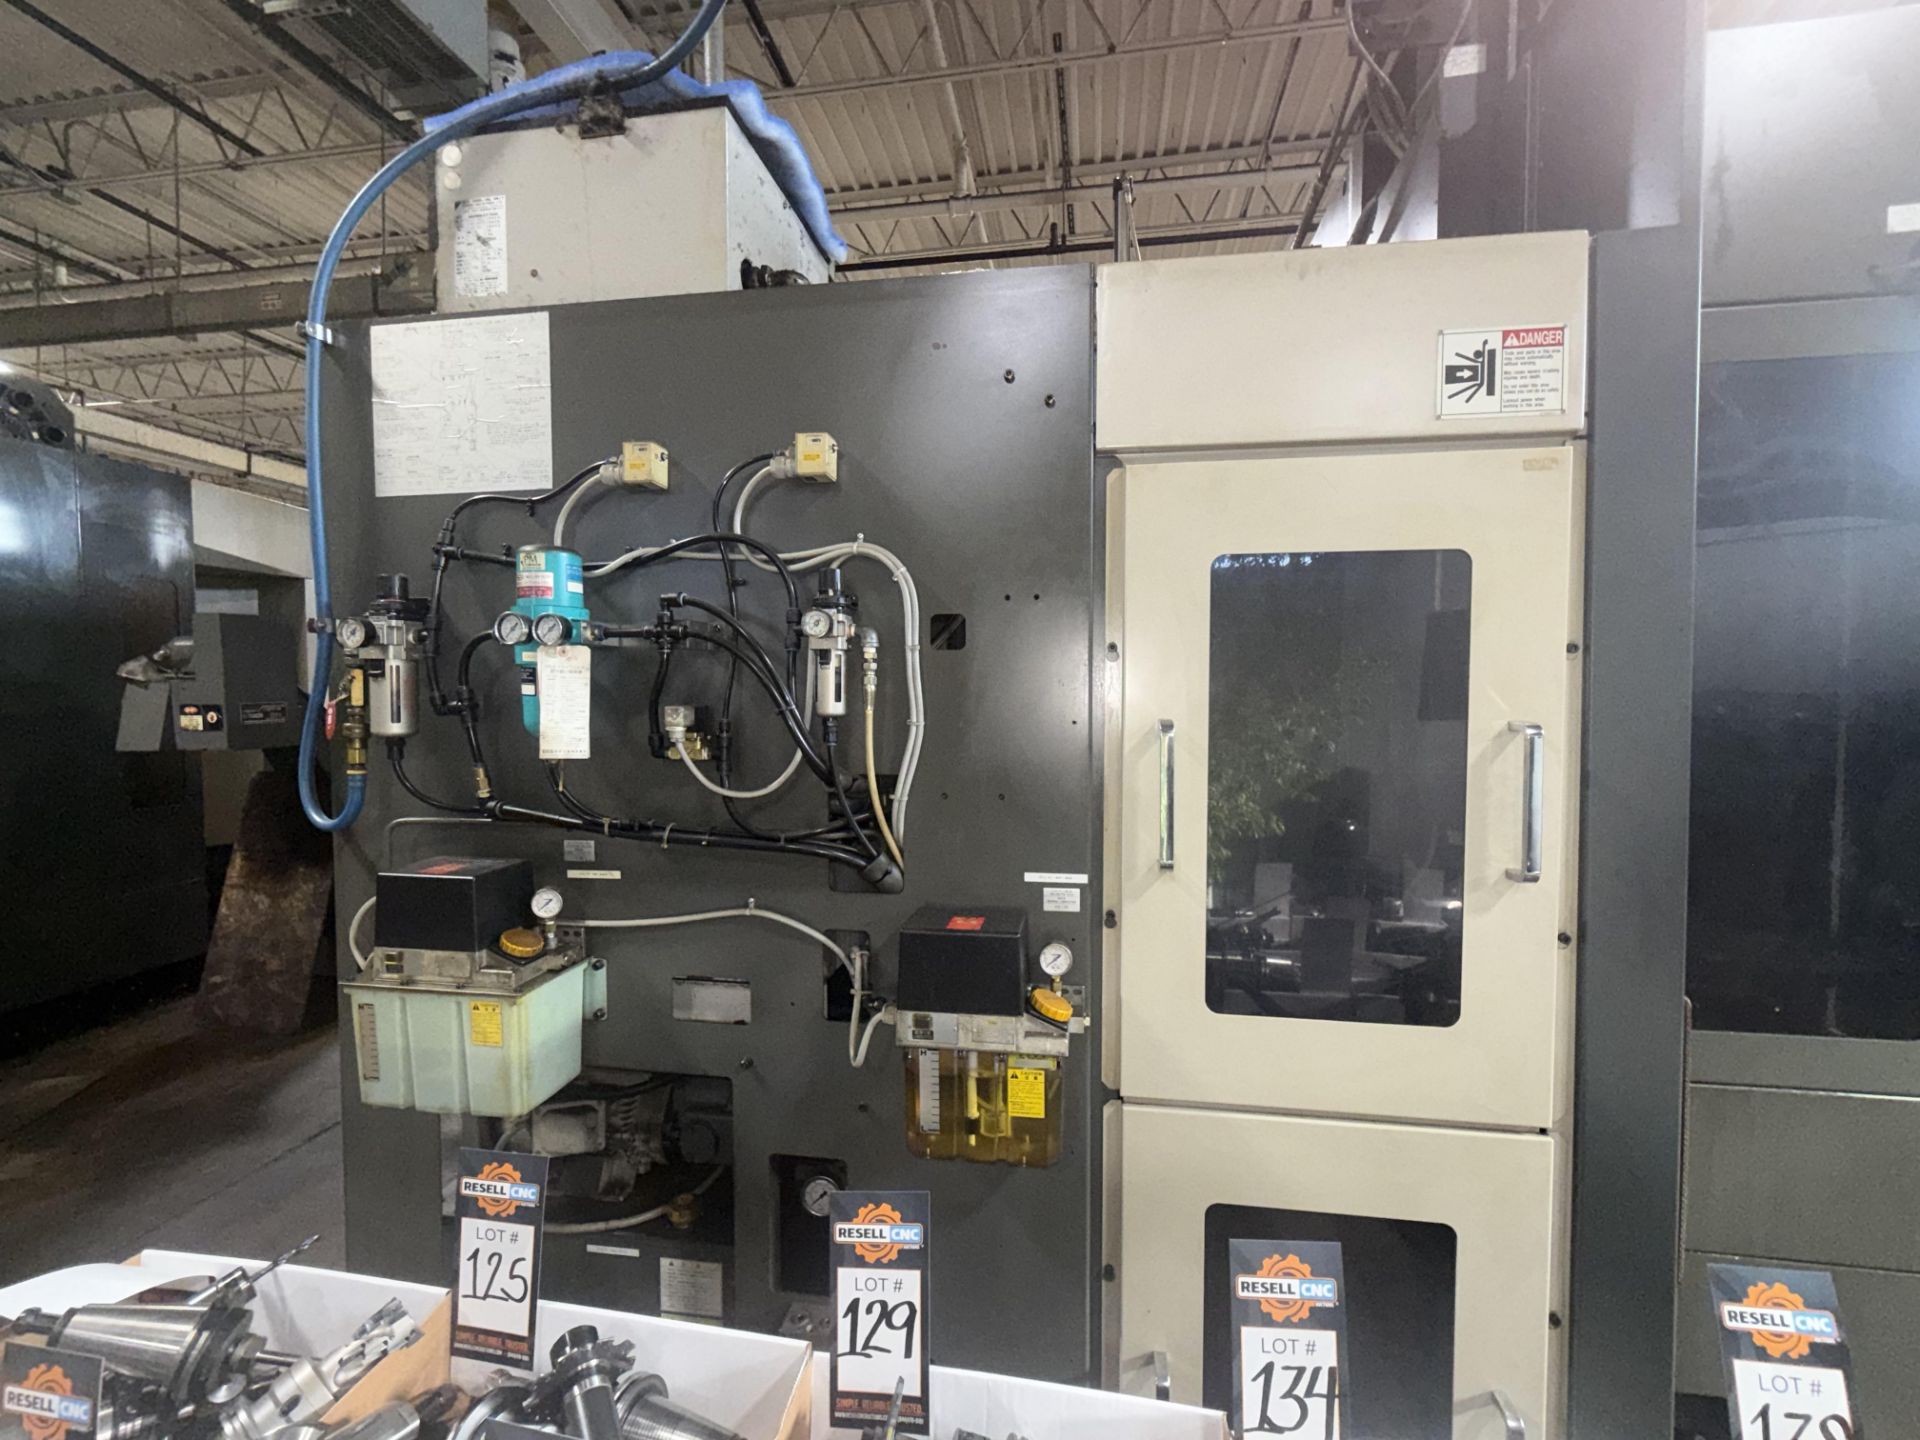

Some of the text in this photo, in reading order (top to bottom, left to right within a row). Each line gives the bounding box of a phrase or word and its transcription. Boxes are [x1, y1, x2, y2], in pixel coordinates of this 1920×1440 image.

[1520, 330, 1563, 345] DANGER
[464, 1182, 536, 1199] RESELL CNC
[476, 1226, 519, 1244] LOT #
[838, 1228, 919, 1240] RESELL CNC
[462, 1248, 528, 1304] 125
[855, 1277, 903, 1292] LOT #
[1240, 1280, 1333, 1297] RESELL CNC
[836, 1298, 918, 1359] 129
[1728, 1310, 1832, 1332] RESELL CNC
[1261, 1338, 1317, 1356] LOT #
[1758, 1374, 1822, 1397] LOT #
[7, 1390, 89, 1420] RESELL CNC
[1244, 1361, 1340, 1440] 134
